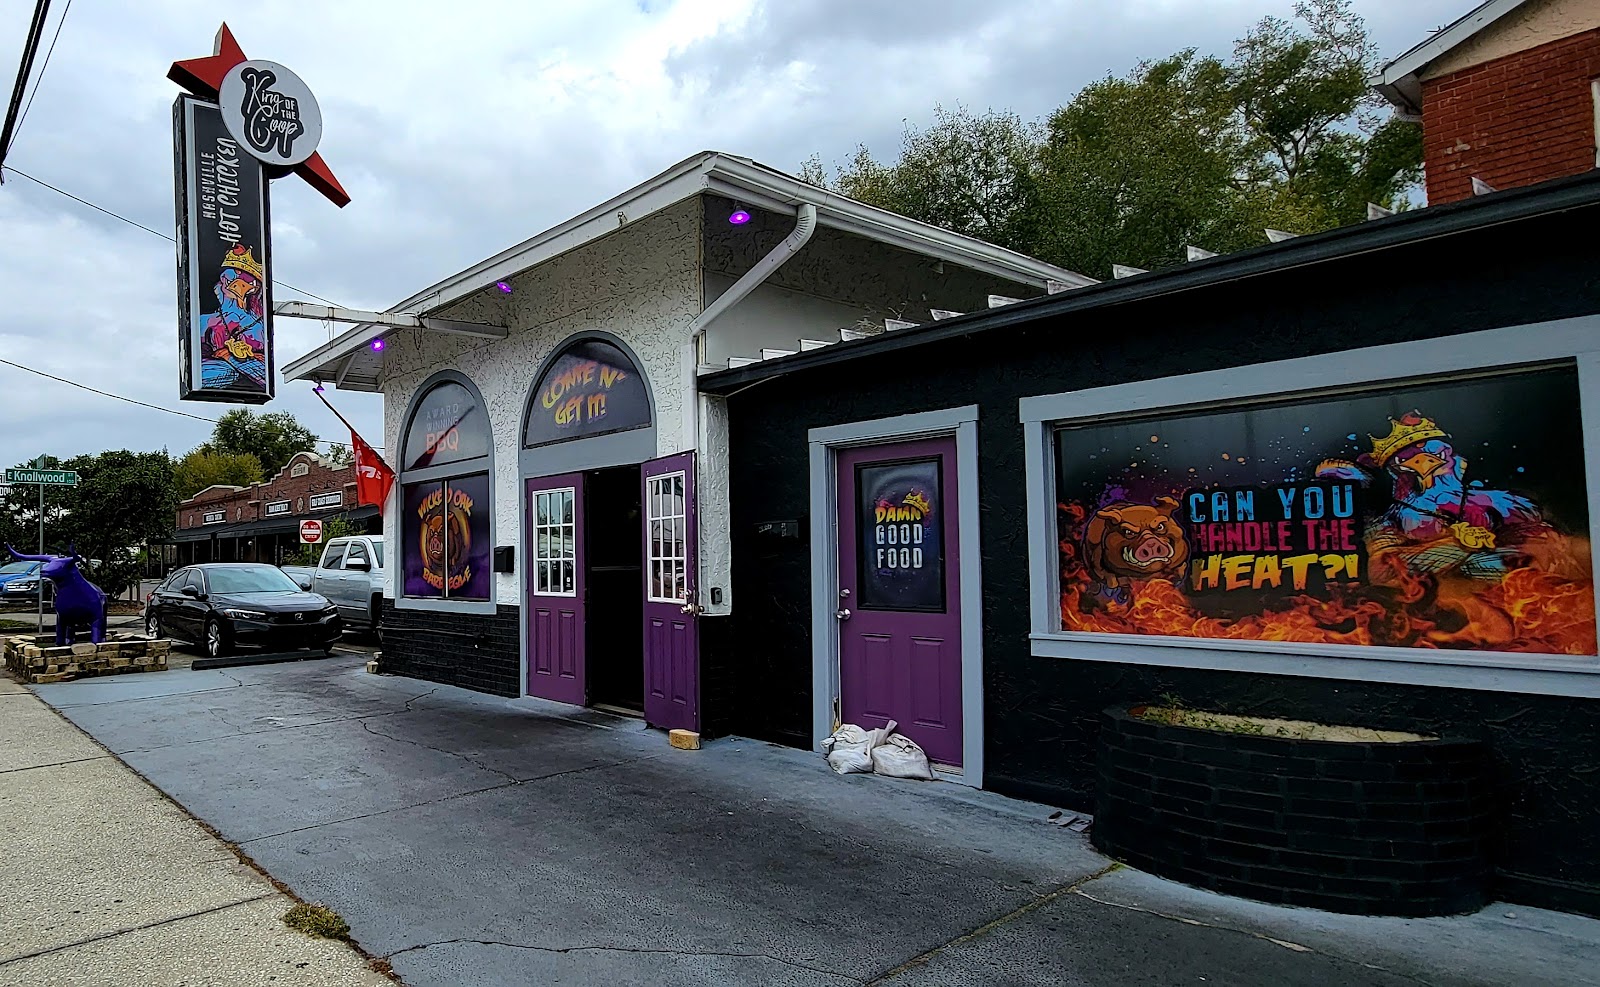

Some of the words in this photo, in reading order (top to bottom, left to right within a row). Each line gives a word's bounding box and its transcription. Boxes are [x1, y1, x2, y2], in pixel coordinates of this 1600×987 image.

[247, 73, 284, 115] King
[284, 99, 296, 111] OF
[250, 105, 298, 152] Coop
[280, 110, 297, 120] THE
[201, 152, 216, 219] NASHVILLE
[216, 137, 241, 207] CHICKEN
[217, 207, 242, 243] HOT
[542, 361, 598, 408] COME
[426, 403, 459, 421] AWARD
[426, 415, 459, 432] WINNING
[554, 393, 585, 426] GET
[587, 392, 607, 421] IT!
[426, 428, 459, 454] BBQ
[7, 471, 13, 480] E
[14, 470, 65, 483] Knollwood
[453, 489, 474, 517] OAK
[875, 506, 922, 524] DAMN
[1189, 490, 1255, 523] CAN
[1277, 484, 1354, 520] YOU
[876, 523, 923, 545] GOOD
[1190, 520, 1294, 552] HANDLE
[1302, 518, 1358, 551] THE
[877, 548, 923, 569] FOOD
[1190, 552, 1359, 592] HEAT?!
[422, 564, 472, 591] BARBEQUE
